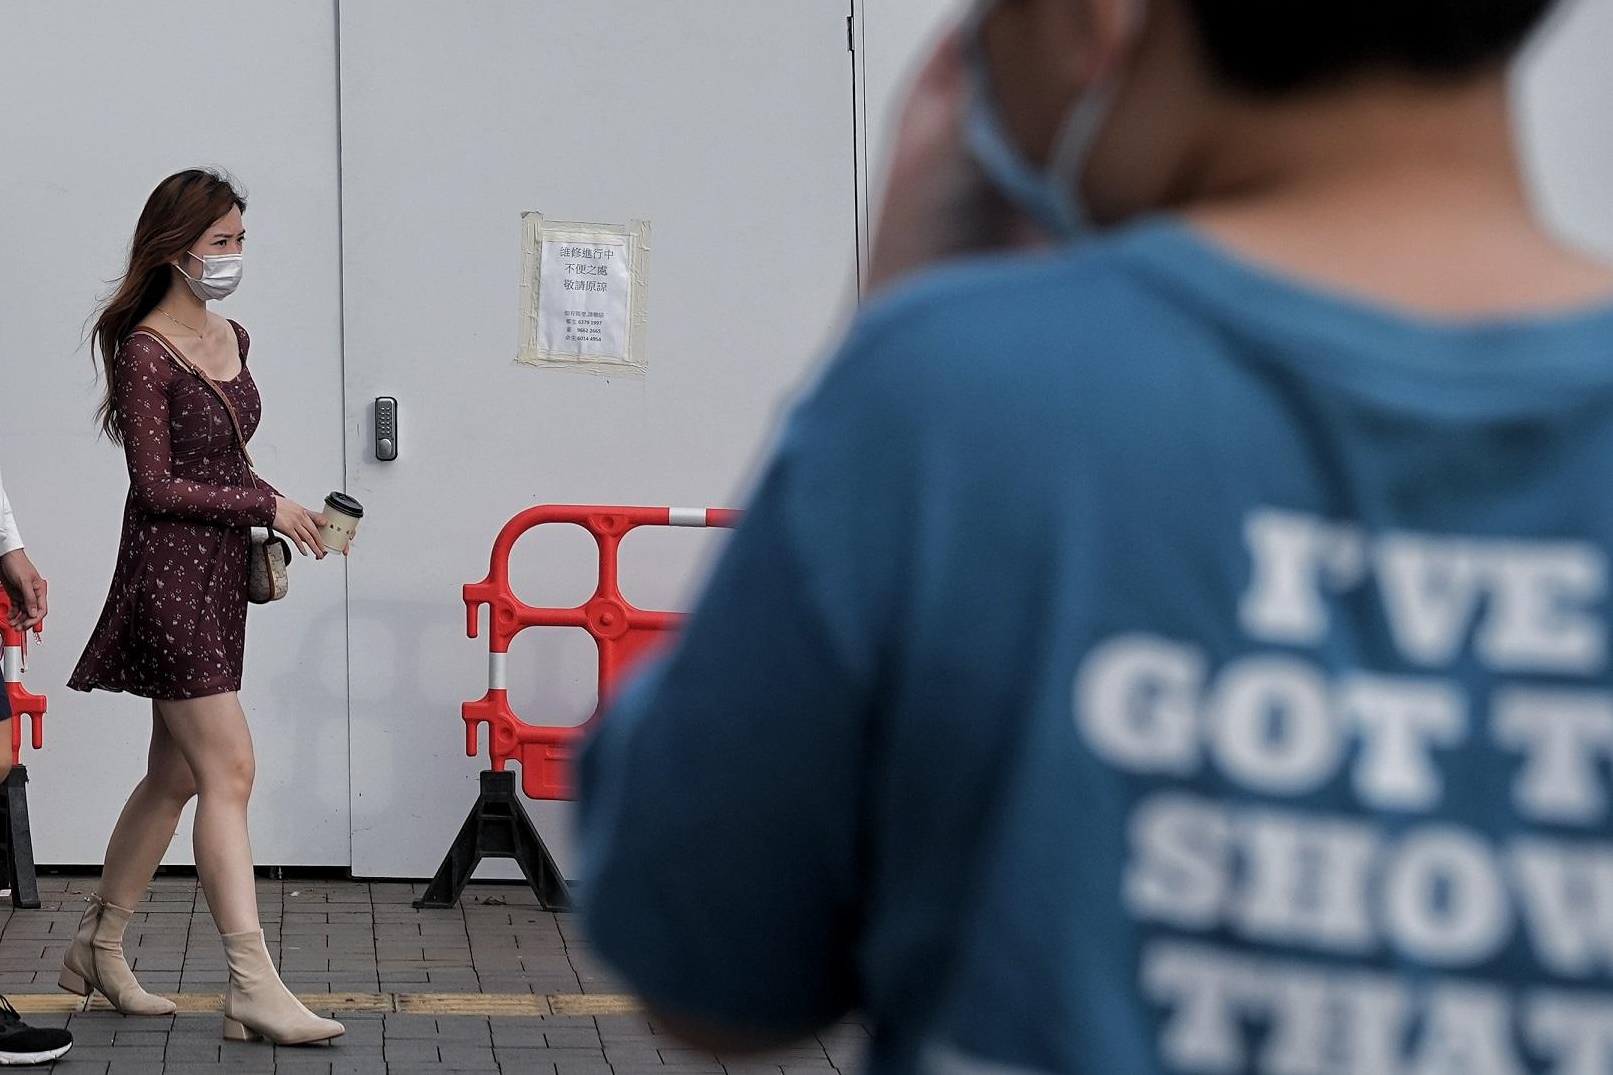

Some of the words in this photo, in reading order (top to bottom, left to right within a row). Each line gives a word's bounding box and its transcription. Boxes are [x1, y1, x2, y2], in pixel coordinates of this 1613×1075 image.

[560, 246, 614, 260] 維修進行中
[564, 263, 608, 276] 不便之處
[563, 279, 608, 292] 敬請原諒
[1238, 506, 1608, 674] I'VE
[1072, 632, 1468, 814] GOT
